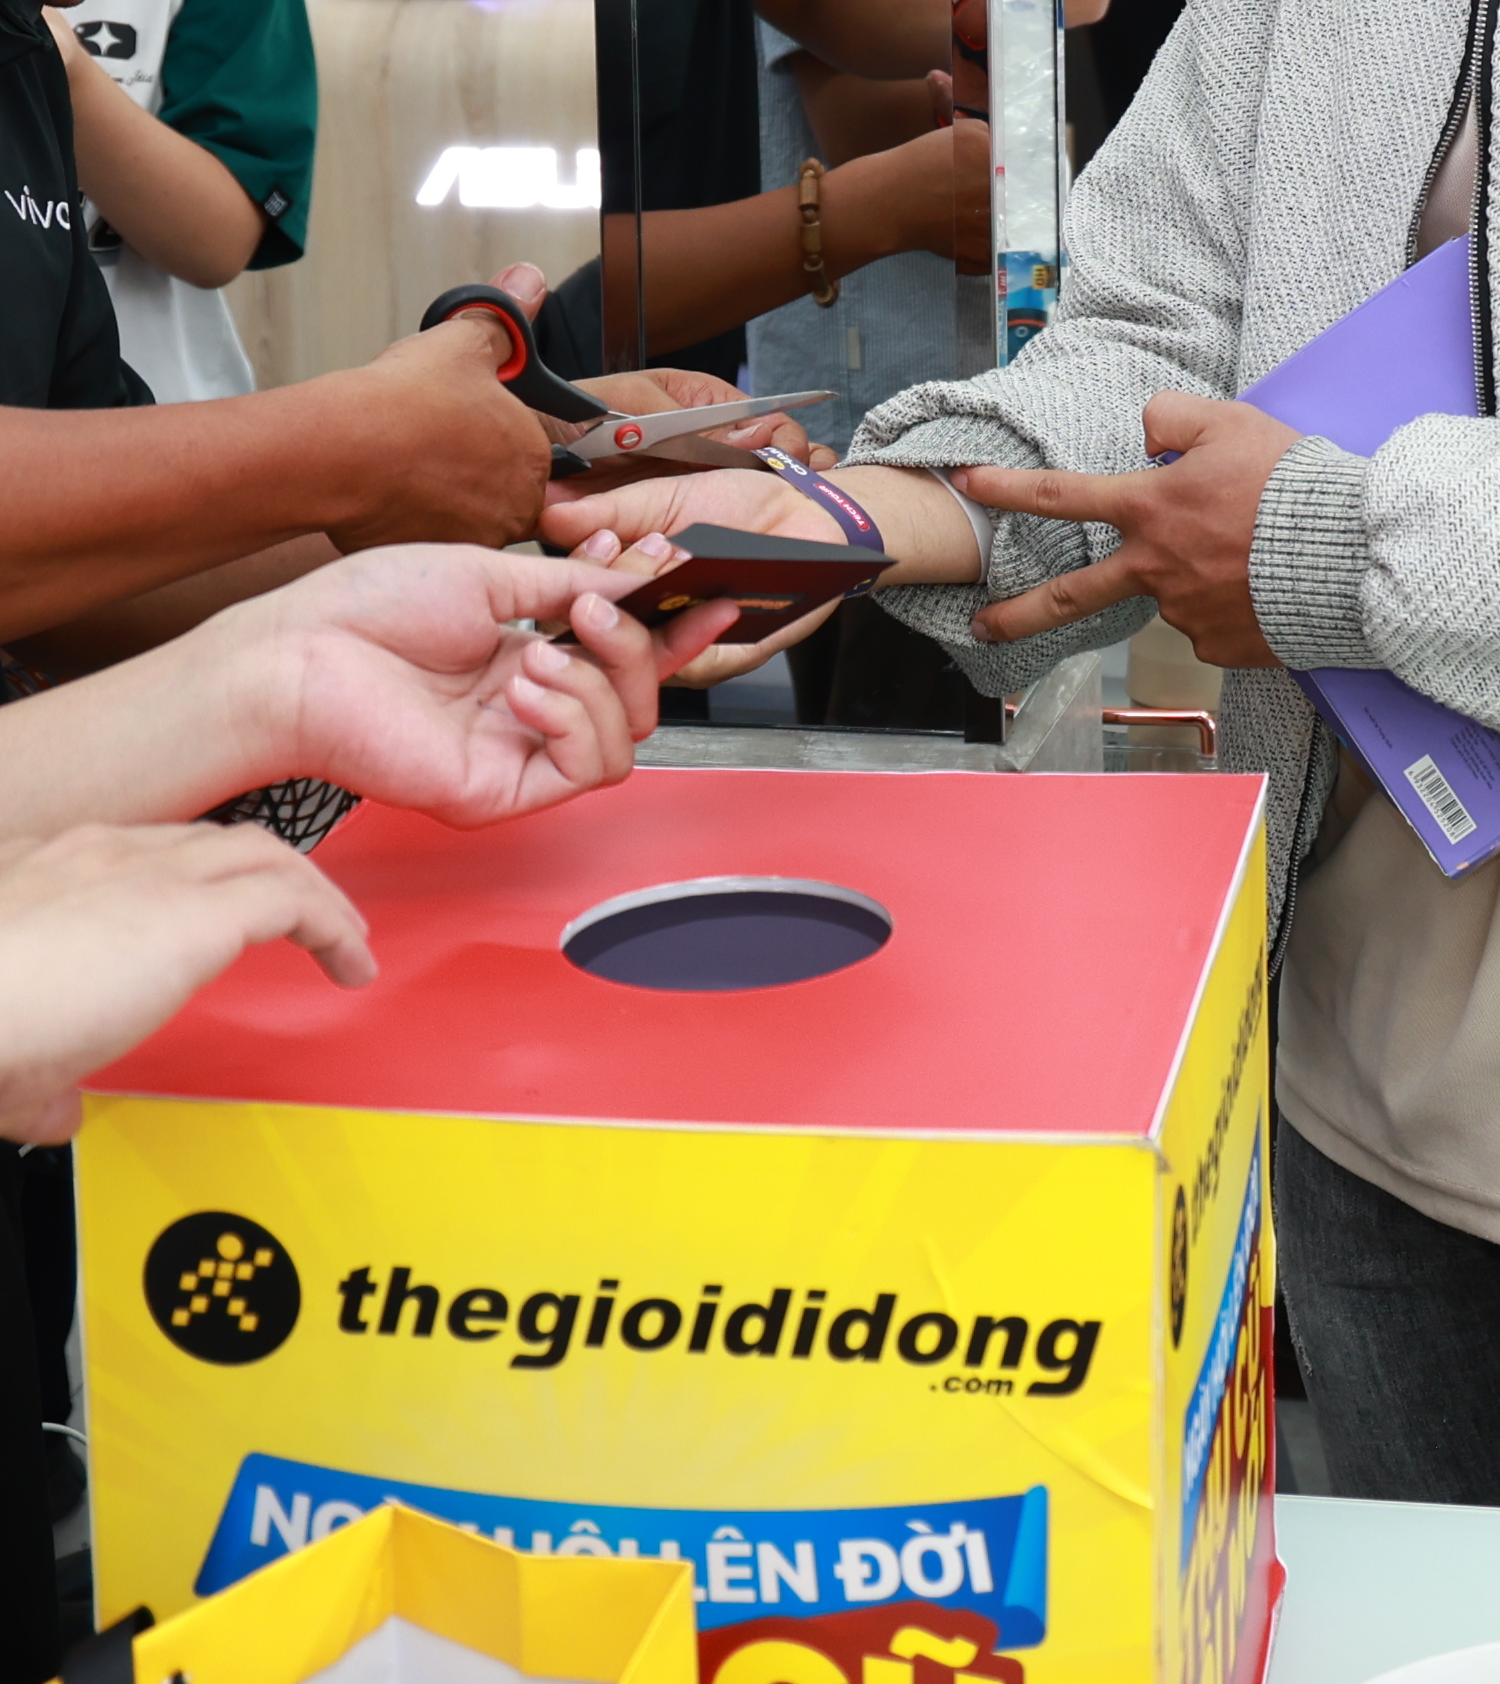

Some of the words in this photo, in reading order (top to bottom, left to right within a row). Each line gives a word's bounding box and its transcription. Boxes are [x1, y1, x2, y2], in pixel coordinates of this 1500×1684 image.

[415, 146, 601, 209] ASU
[819, 485, 843, 506] TOUR
[843, 503, 866, 526] TECH
[337, 1265, 1104, 1398] thegioididong
[929, 1372, 1015, 1397] .com
[835, 1521, 994, 1601] ĐỜI
